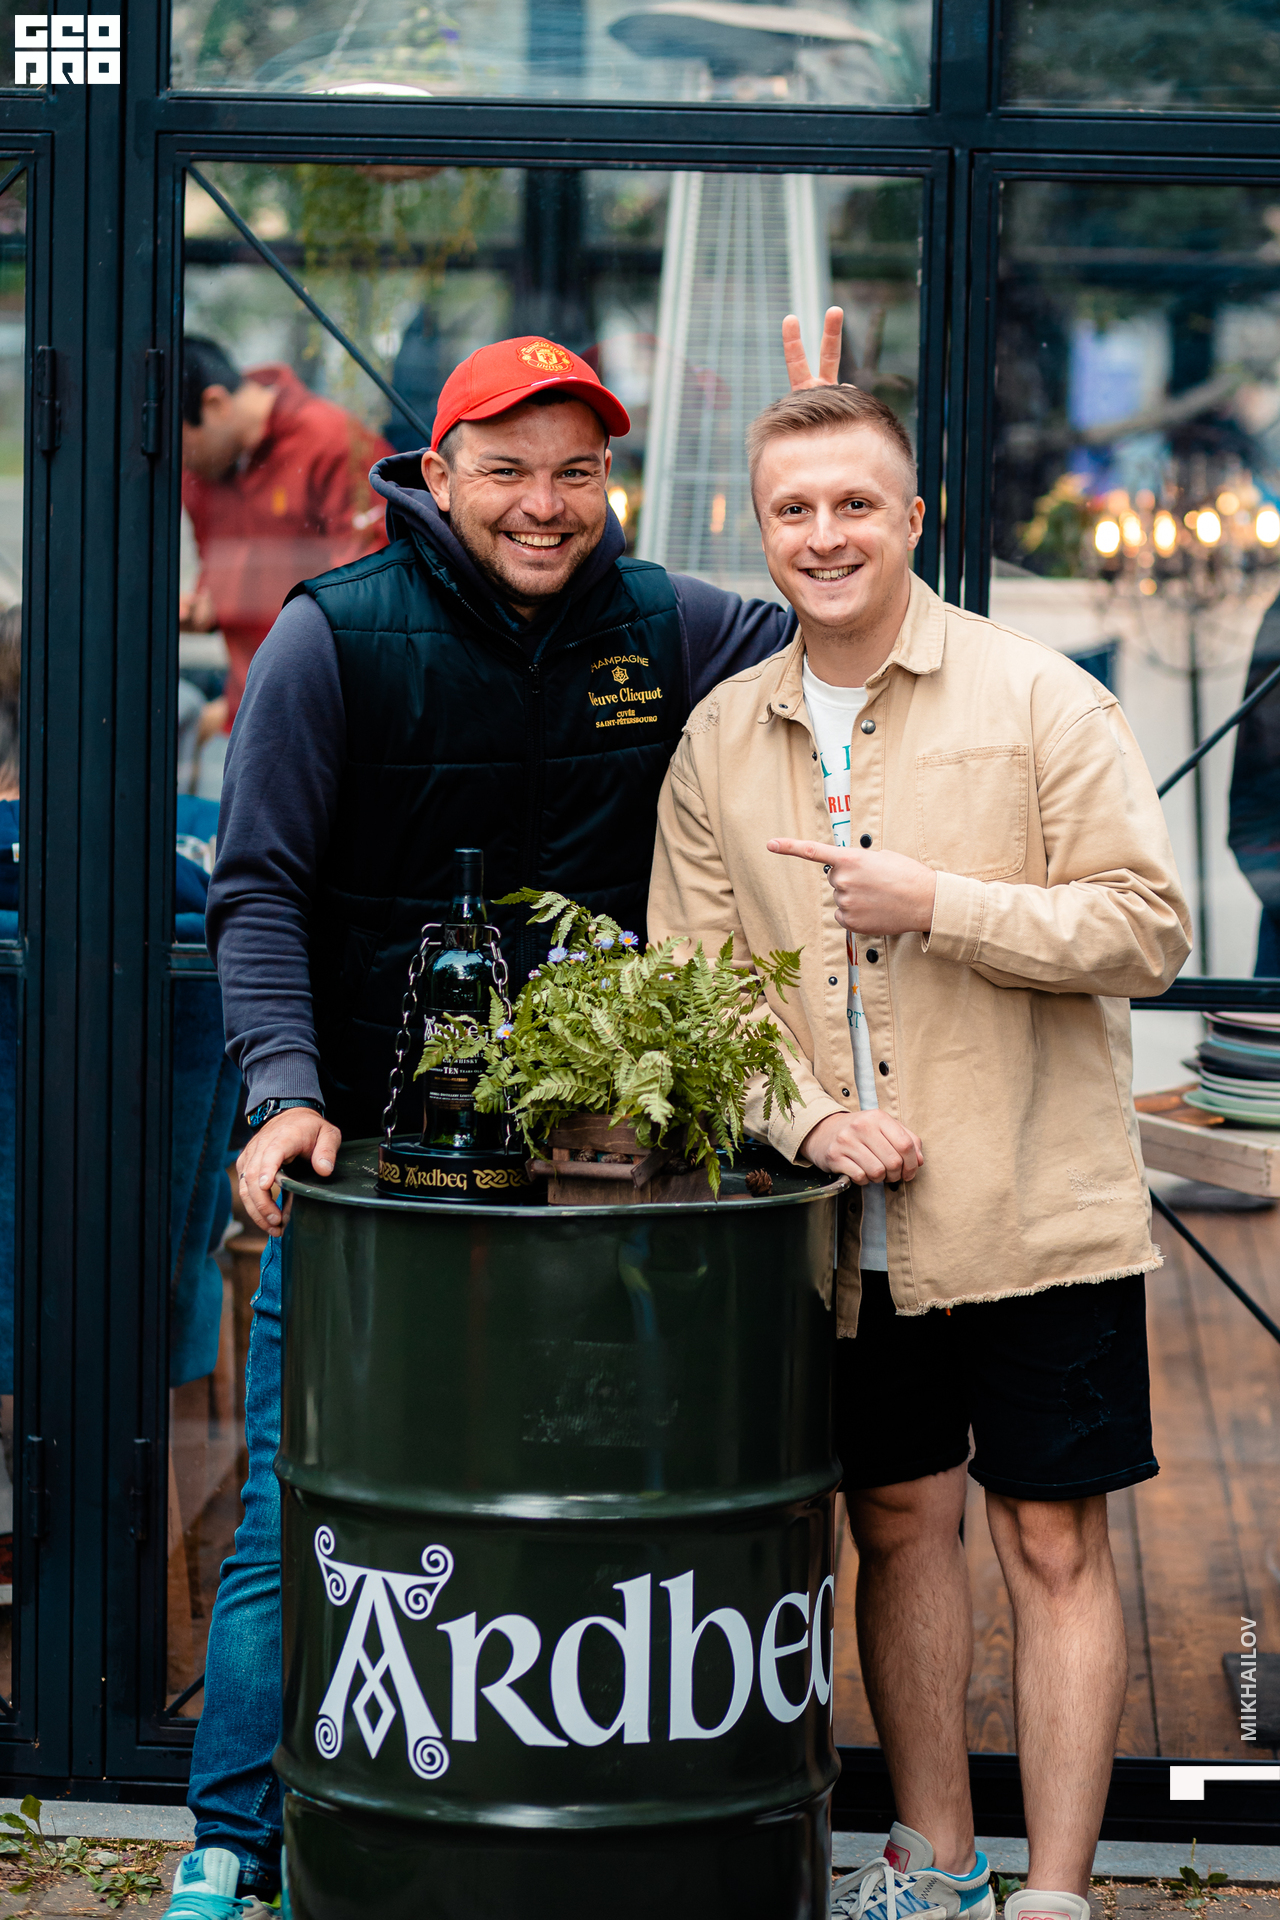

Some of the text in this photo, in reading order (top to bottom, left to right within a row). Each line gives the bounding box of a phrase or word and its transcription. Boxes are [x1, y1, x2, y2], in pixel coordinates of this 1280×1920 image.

[591, 655, 649, 673] HAMPAGNE
[619, 687, 663, 704] Clicquot
[828, 794, 851, 814] RLD
[443, 1066, 459, 1075] TEN
[404, 1164, 467, 1191] Ardbeg
